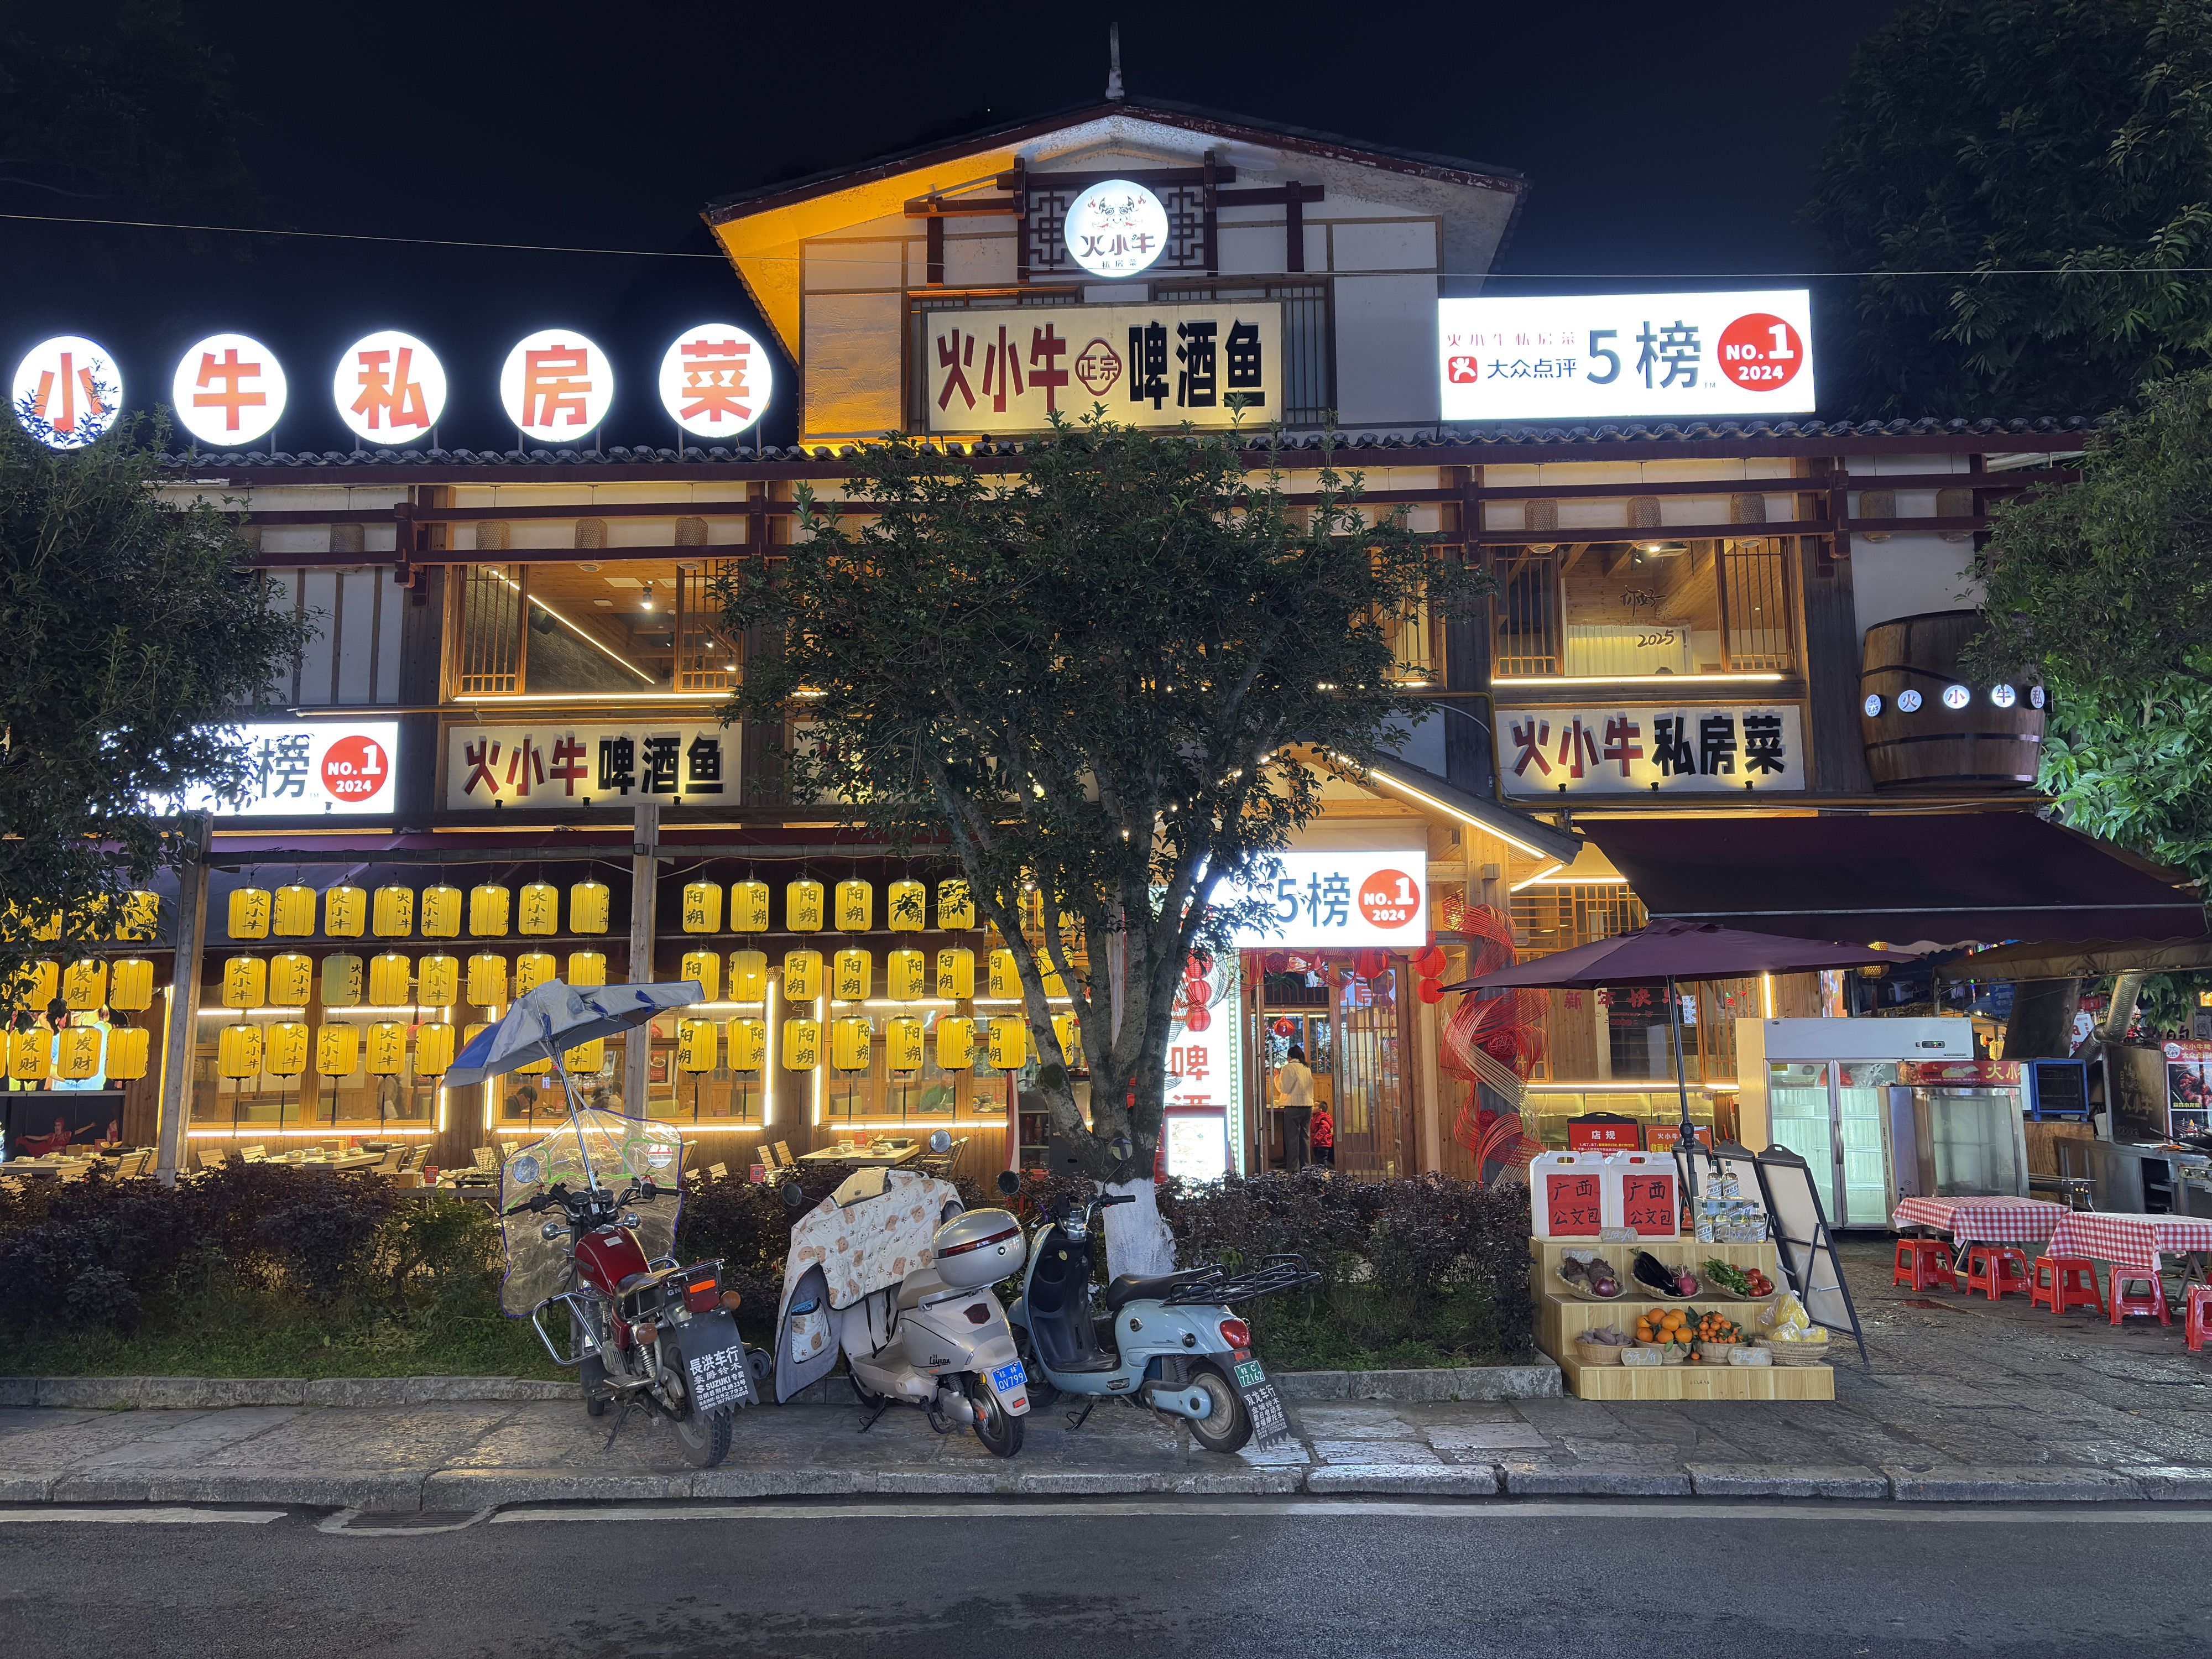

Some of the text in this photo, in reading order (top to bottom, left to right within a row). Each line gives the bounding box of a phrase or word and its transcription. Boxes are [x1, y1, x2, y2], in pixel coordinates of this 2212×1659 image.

[1079, 233, 1155, 258] 火小牛
[1102, 259, 1137, 268] 私房菜
[1726, 324, 1794, 360] NO.1
[937, 317, 1265, 413] 火小牛 正宗 啤酒鱼
[1487, 358, 1578, 378] 大众点评
[1738, 365, 1785, 380] 2024
[1619, 585, 1667, 617] 你好
[1637, 629, 1674, 648] 2025
[327, 744, 382, 775] NO.1
[1512, 716, 1785, 779] 火小牛私房菜
[335, 780, 372, 793] 2024
[525, 891, 548, 927] 火小牛
[686, 889, 705, 925] 阳朔
[749, 889, 766, 926] 阳朔
[798, 887, 818, 924] 阳朔
[845, 886, 865, 922] 阳朔
[1364, 877, 1414, 905] NO.1
[242, 895, 265, 930] 火小牛
[330, 894, 351, 930] 火小牛
[397, 893, 411, 929] 火小牛
[422, 894, 440, 930] 火小牛
[1372, 910, 1406, 921] 2024
[67, 967, 92, 1003] 发财
[230, 964, 253, 1001] 火小牛
[290, 962, 310, 999] 火小牛
[347, 963, 362, 999] 火小牛
[426, 961, 449, 1001] 火小牛
[787, 957, 808, 995] 阳朔
[841, 957, 862, 995] 阳朔
[905, 958, 924, 995] 阳朔
[938, 954, 955, 990] 阳朔
[18, 1036, 40, 1072] 发财
[70, 1036, 93, 1072] 发财
[244, 1034, 260, 1070] 火小牛
[281, 1027, 305, 1067] 火小牛
[319, 1031, 340, 1071] 火小牛
[377, 1030, 399, 1067] 火小牛
[679, 1028, 695, 1065] 阳朔
[749, 1026, 765, 1063] 阳朔
[795, 1027, 816, 1065] 阳朔
[855, 1024, 870, 1061] 阳朔
[903, 1025, 922, 1062] 阳朔
[989, 1026, 1002, 1063] 阳朔
[1985, 1063, 2021, 1080] 火小
[1592, 1130, 1616, 1140] 店规
[1554, 1180, 1593, 1201] 广西
[1628, 1181, 1666, 1202] 广西
[1553, 1206, 1600, 1225] 公文包
[1630, 1208, 1671, 1226] 公文包
[693, 1362, 742, 1385] 豪爵铃木
[705, 1371, 745, 1391] SUZUKI 专卖
[998, 1372, 1024, 1390] QV799
[999, 1366, 1017, 1379] 桂林
[1240, 1371, 1264, 1385] 7Z162
[1244, 1384, 1276, 1406] 双龙车行
[1251, 1397, 1280, 1415] 金城铃木
[1253, 1404, 1282, 1422] 新日电动车
[1255, 1411, 1284, 1429] 幸福摩托车
